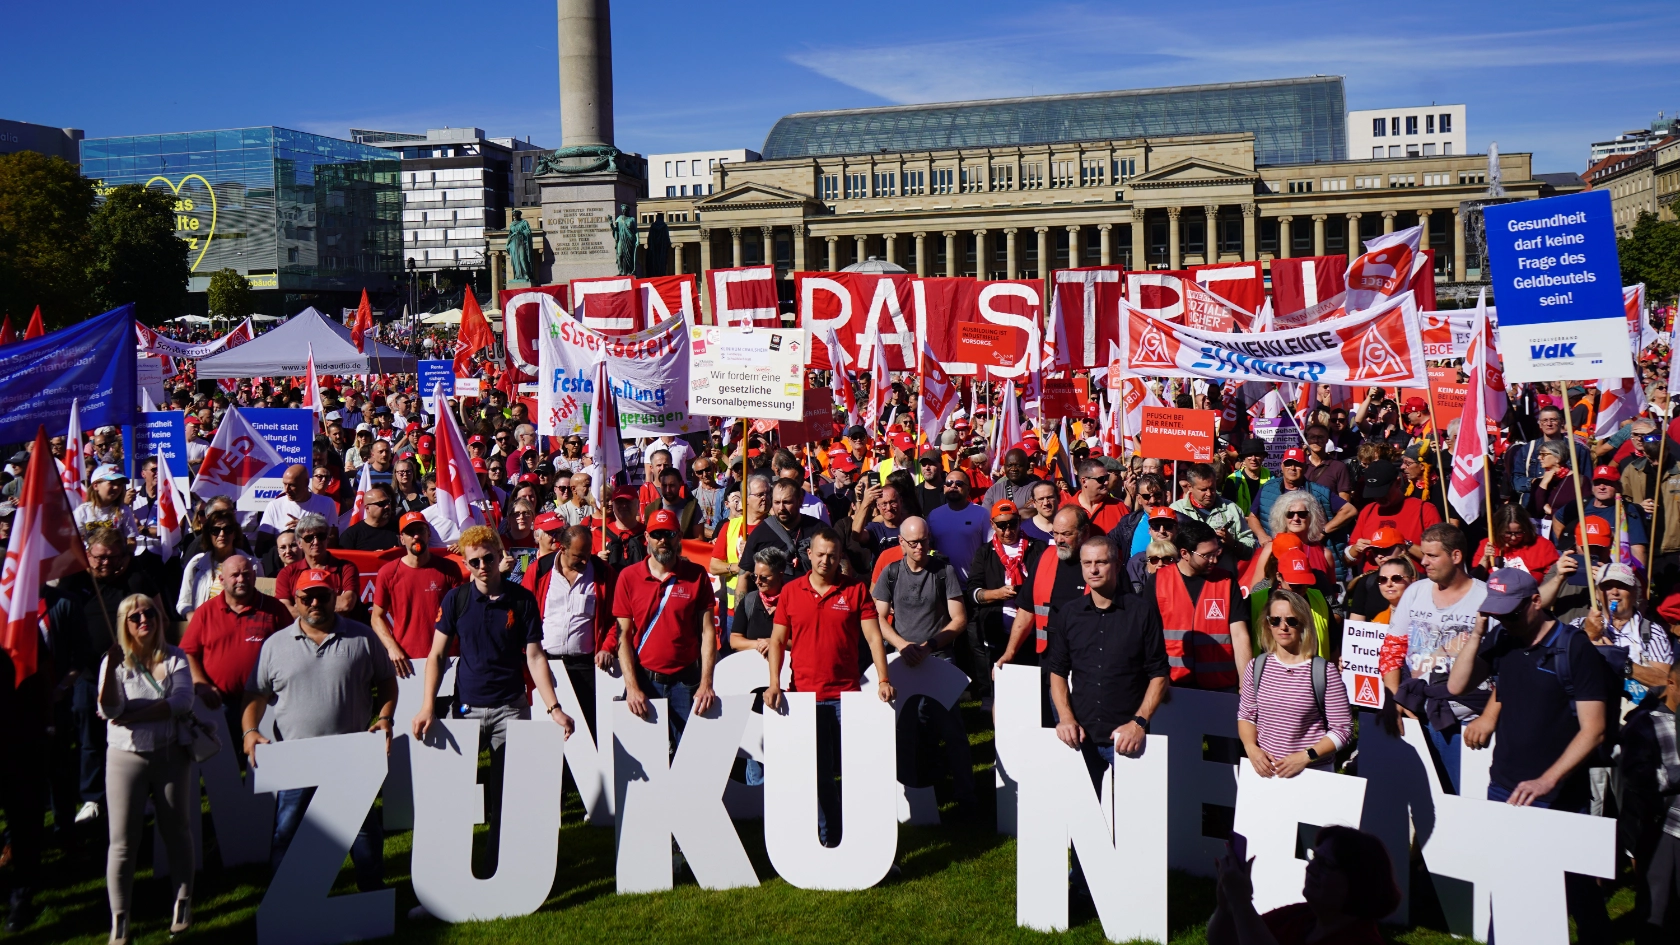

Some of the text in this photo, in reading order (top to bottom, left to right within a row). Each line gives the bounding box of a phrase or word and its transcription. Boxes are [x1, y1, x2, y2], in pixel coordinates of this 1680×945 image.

[171, 198, 194, 212] as
[1507, 211, 1587, 232] Gesundheit
[1514, 233, 1585, 251] darf keine
[1518, 253, 1586, 270] Frage des
[1513, 271, 1597, 290] Geldbeutels
[1539, 292, 1573, 307] sein!
[962, 326, 997, 335] AUSBILDUNG
[961, 338, 993, 346] VORSORGE.
[962, 332, 1000, 341] INDUSTRIELLE
[1530, 342, 1577, 360] VdK
[281, 363, 361, 371] www.scmid-audio.de
[710, 370, 781, 383] Wir fordern eine
[718, 384, 772, 395] gesetzliche
[1437, 386, 1454, 394] KEIN
[696, 395, 795, 412] Personalbemessung!
[1146, 412, 1172, 421] PFUSCH
[280, 422, 299, 431] statt
[1146, 419, 1184, 428] DER RENTE:
[151, 431, 171, 439] keine
[1145, 426, 1209, 438] FÜR FRAUEN FATAL.
[289, 434, 297, 442] in
[276, 445, 301, 454] Pflege
[1409, 609, 1433, 619] CAMP
[1347, 626, 1386, 640] Daimle
[1352, 644, 1381, 657] Truck
[1344, 661, 1380, 675] Zentra
